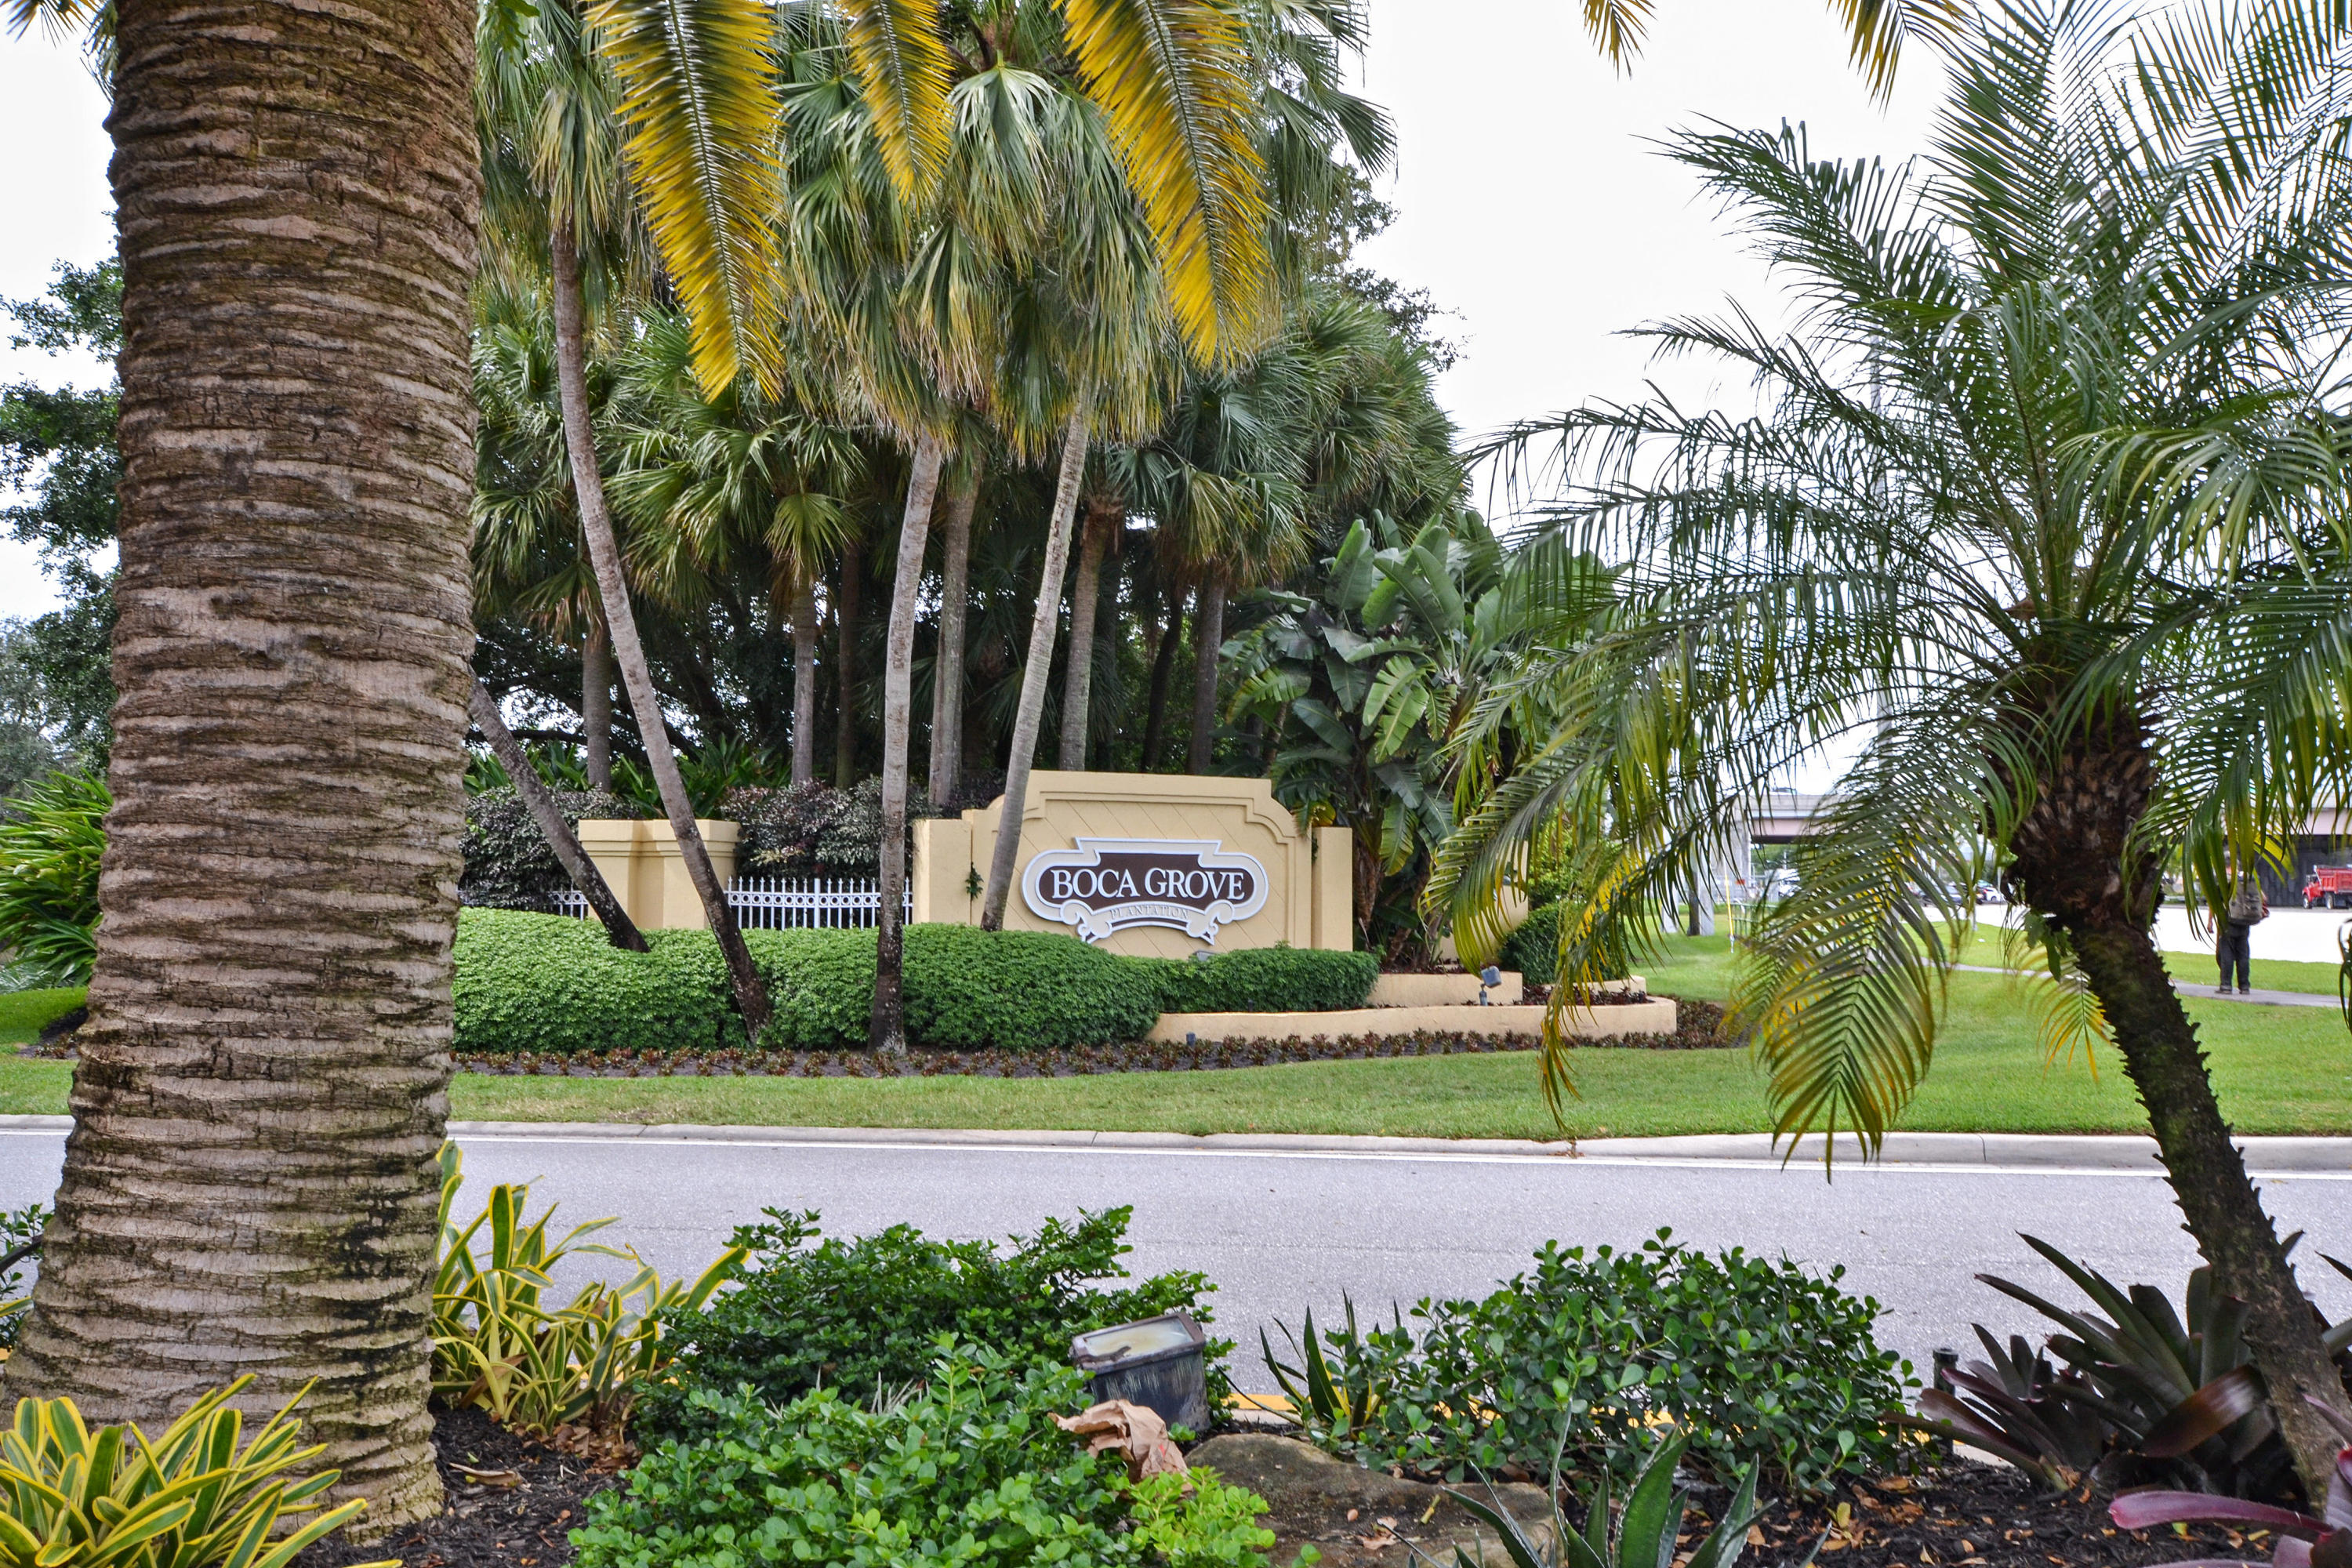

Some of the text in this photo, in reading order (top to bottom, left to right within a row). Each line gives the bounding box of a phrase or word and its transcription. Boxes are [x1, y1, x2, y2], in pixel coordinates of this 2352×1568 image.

[1051, 867, 1245, 900] BOCA GROVE
[1110, 905, 1189, 920] PLANTATION
